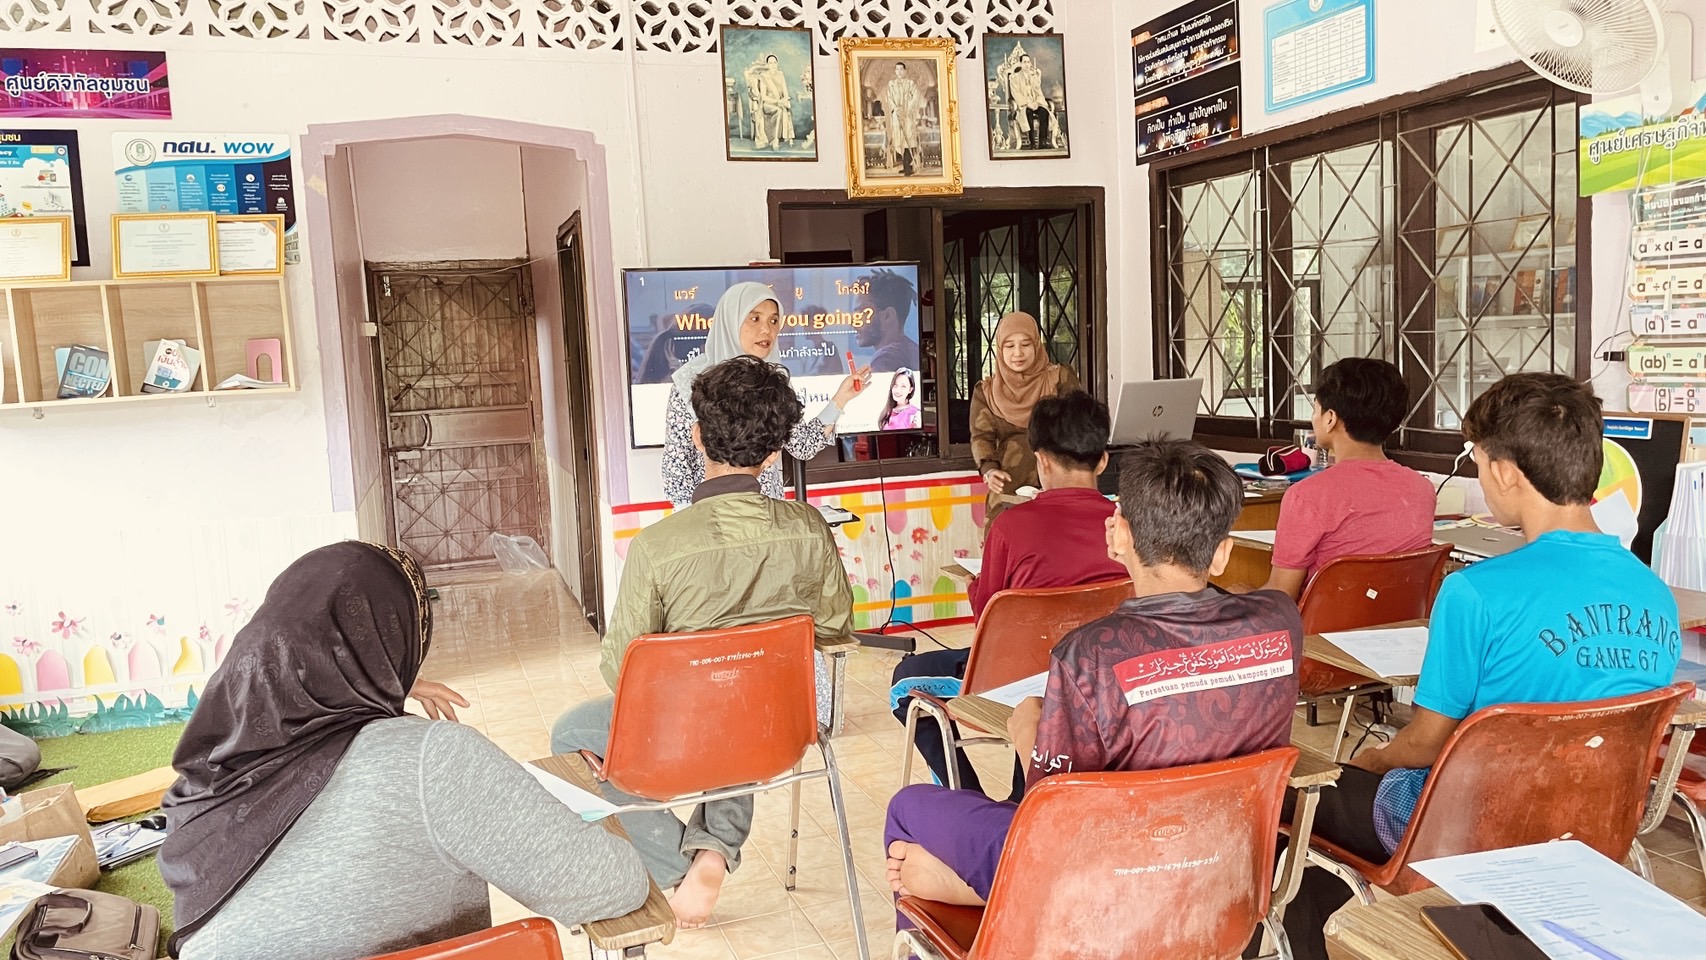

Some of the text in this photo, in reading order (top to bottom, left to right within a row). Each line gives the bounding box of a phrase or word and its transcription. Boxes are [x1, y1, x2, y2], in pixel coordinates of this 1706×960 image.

[6, 72, 149, 97] ศูนย์ดิจิทัลชุมชน
[223, 142, 275, 154] WOW
[639, 276, 645, 287] 1
[674, 286, 698, 300] แวร์
[795, 287, 803, 300] ยู
[813, 308, 874, 329] going?
[1538, 603, 1680, 661] BANTRANG
[1576, 646, 1659, 673] GAME 67
[1139, 684, 1179, 698] Persatuan
[1181, 679, 1208, 690] pemuda
[1211, 675, 1235, 686] pemudi
[1237, 669, 1268, 681] kampong
